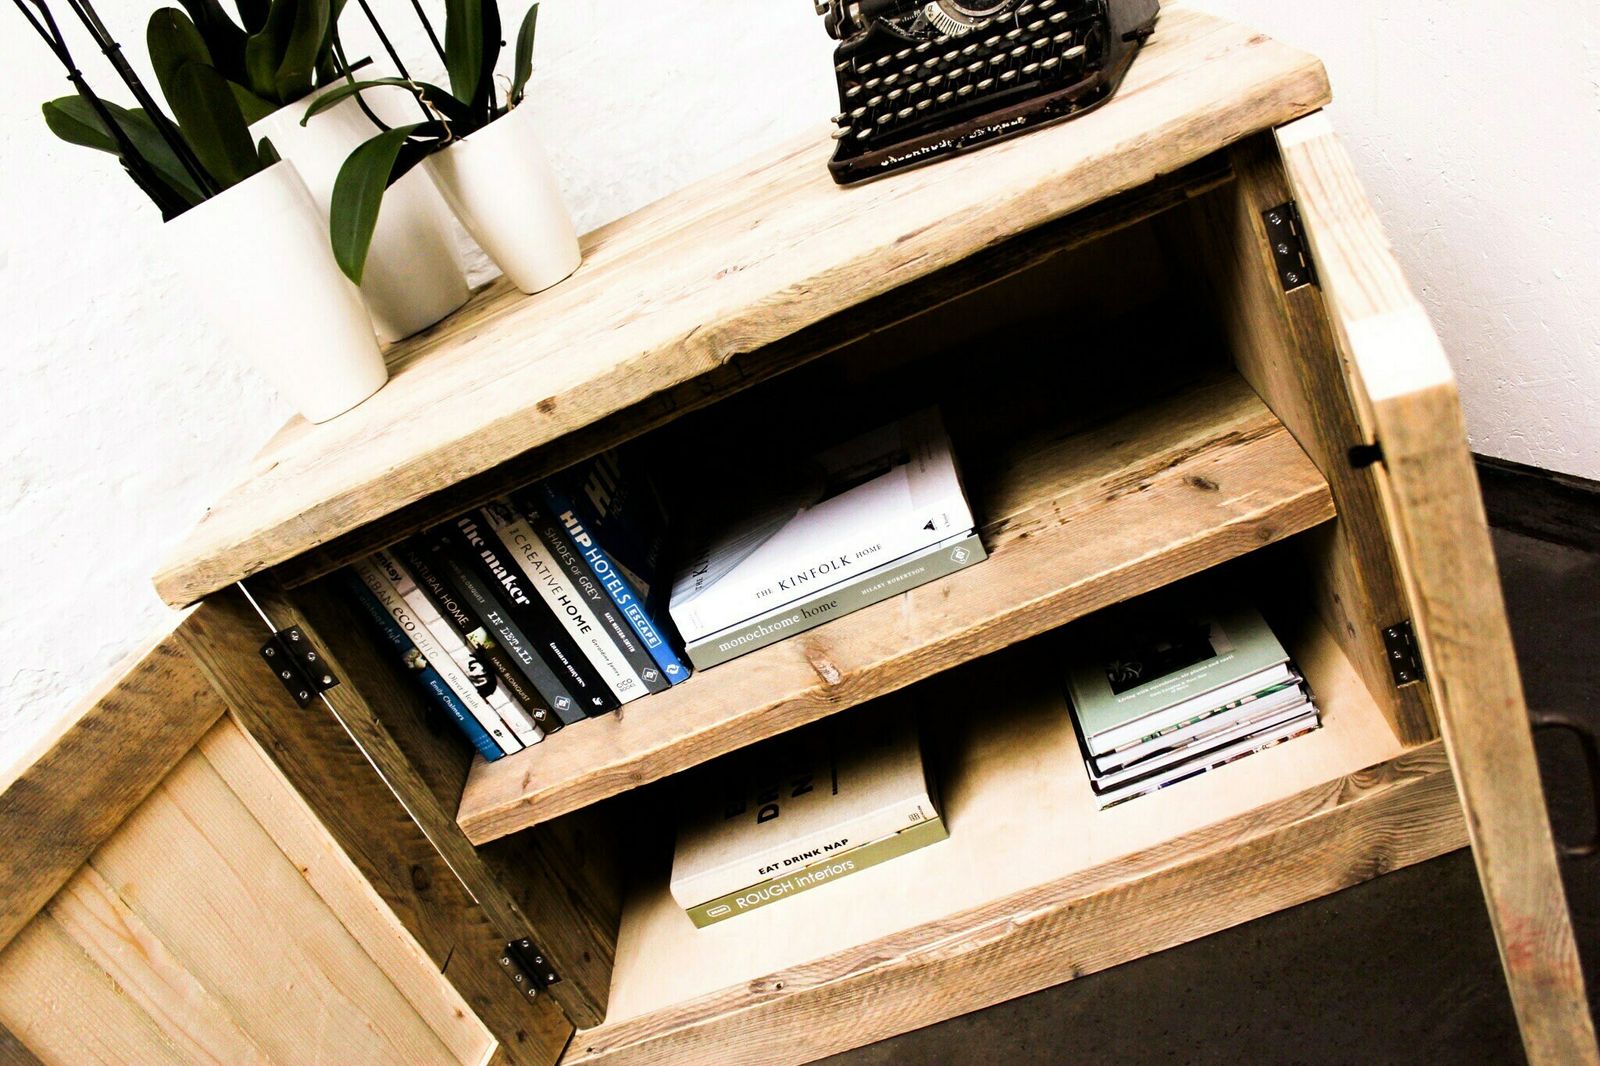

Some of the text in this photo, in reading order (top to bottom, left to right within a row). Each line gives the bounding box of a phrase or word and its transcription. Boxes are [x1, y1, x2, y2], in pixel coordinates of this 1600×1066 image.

[408, 552, 443, 594] NATURAL
[456, 516, 486, 548] the
[480, 548, 532, 606] maker
[514, 534, 592, 634] CREATIVE HOME
[545, 528, 601, 600] SHADES OF GREY
[560, 510, 592, 547] HIP
[585, 548, 631, 604] HOTELS
[628, 607, 658, 645] ESCAPE
[756, 544, 881, 599] THE KINFOLK HOME
[358, 564, 438, 659] URBAN eco CHIC
[487, 611, 504, 626] IN
[500, 627, 533, 664] DETAIL
[718, 614, 800, 652] monochrome
[800, 600, 837, 619] home
[448, 672, 464, 691] Oliver
[492, 657, 506, 672] HANS
[430, 680, 464, 721] Emily Chalmers
[759, 838, 849, 876] EAT DRINK NAP
[736, 860, 855, 909] ROUGH interiors
